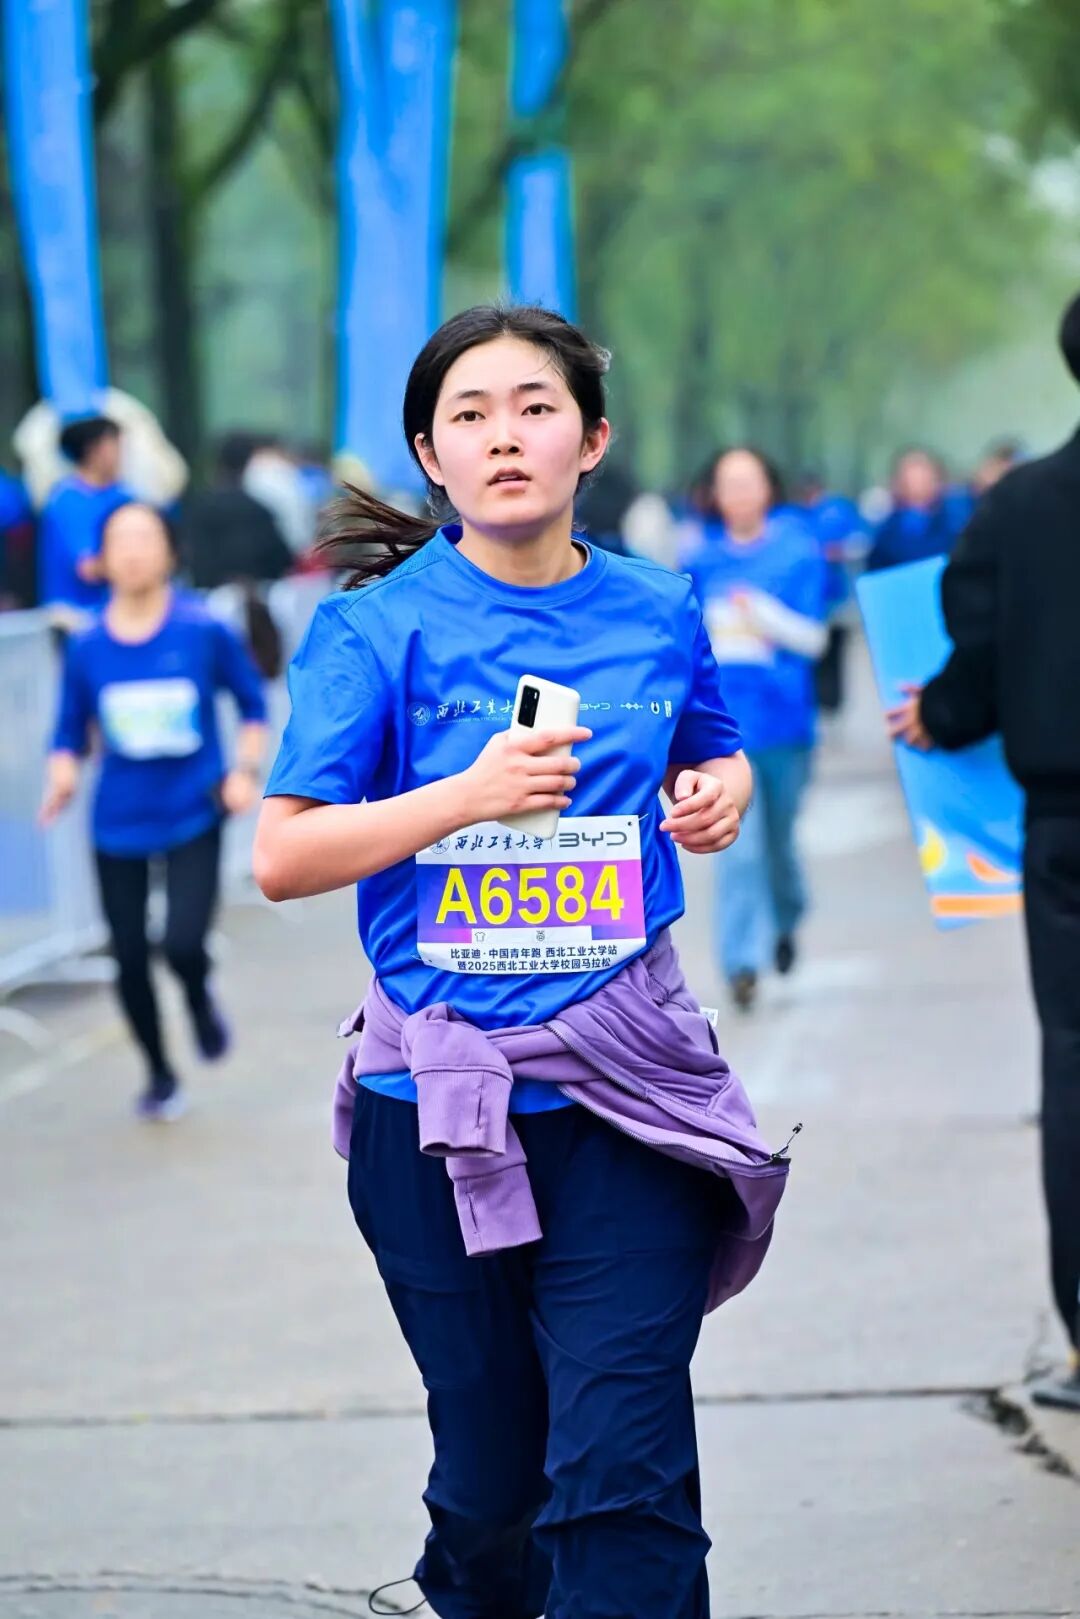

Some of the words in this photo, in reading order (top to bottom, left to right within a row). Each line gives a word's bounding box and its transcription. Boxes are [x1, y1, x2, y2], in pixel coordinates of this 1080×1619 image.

[558, 831, 628, 848] BYD
[435, 864, 625, 925] A6584
[545, 944, 618, 959] 西北工业大学站
[457, 957, 611, 972] 暨2025西北工业大学校园马拉松
